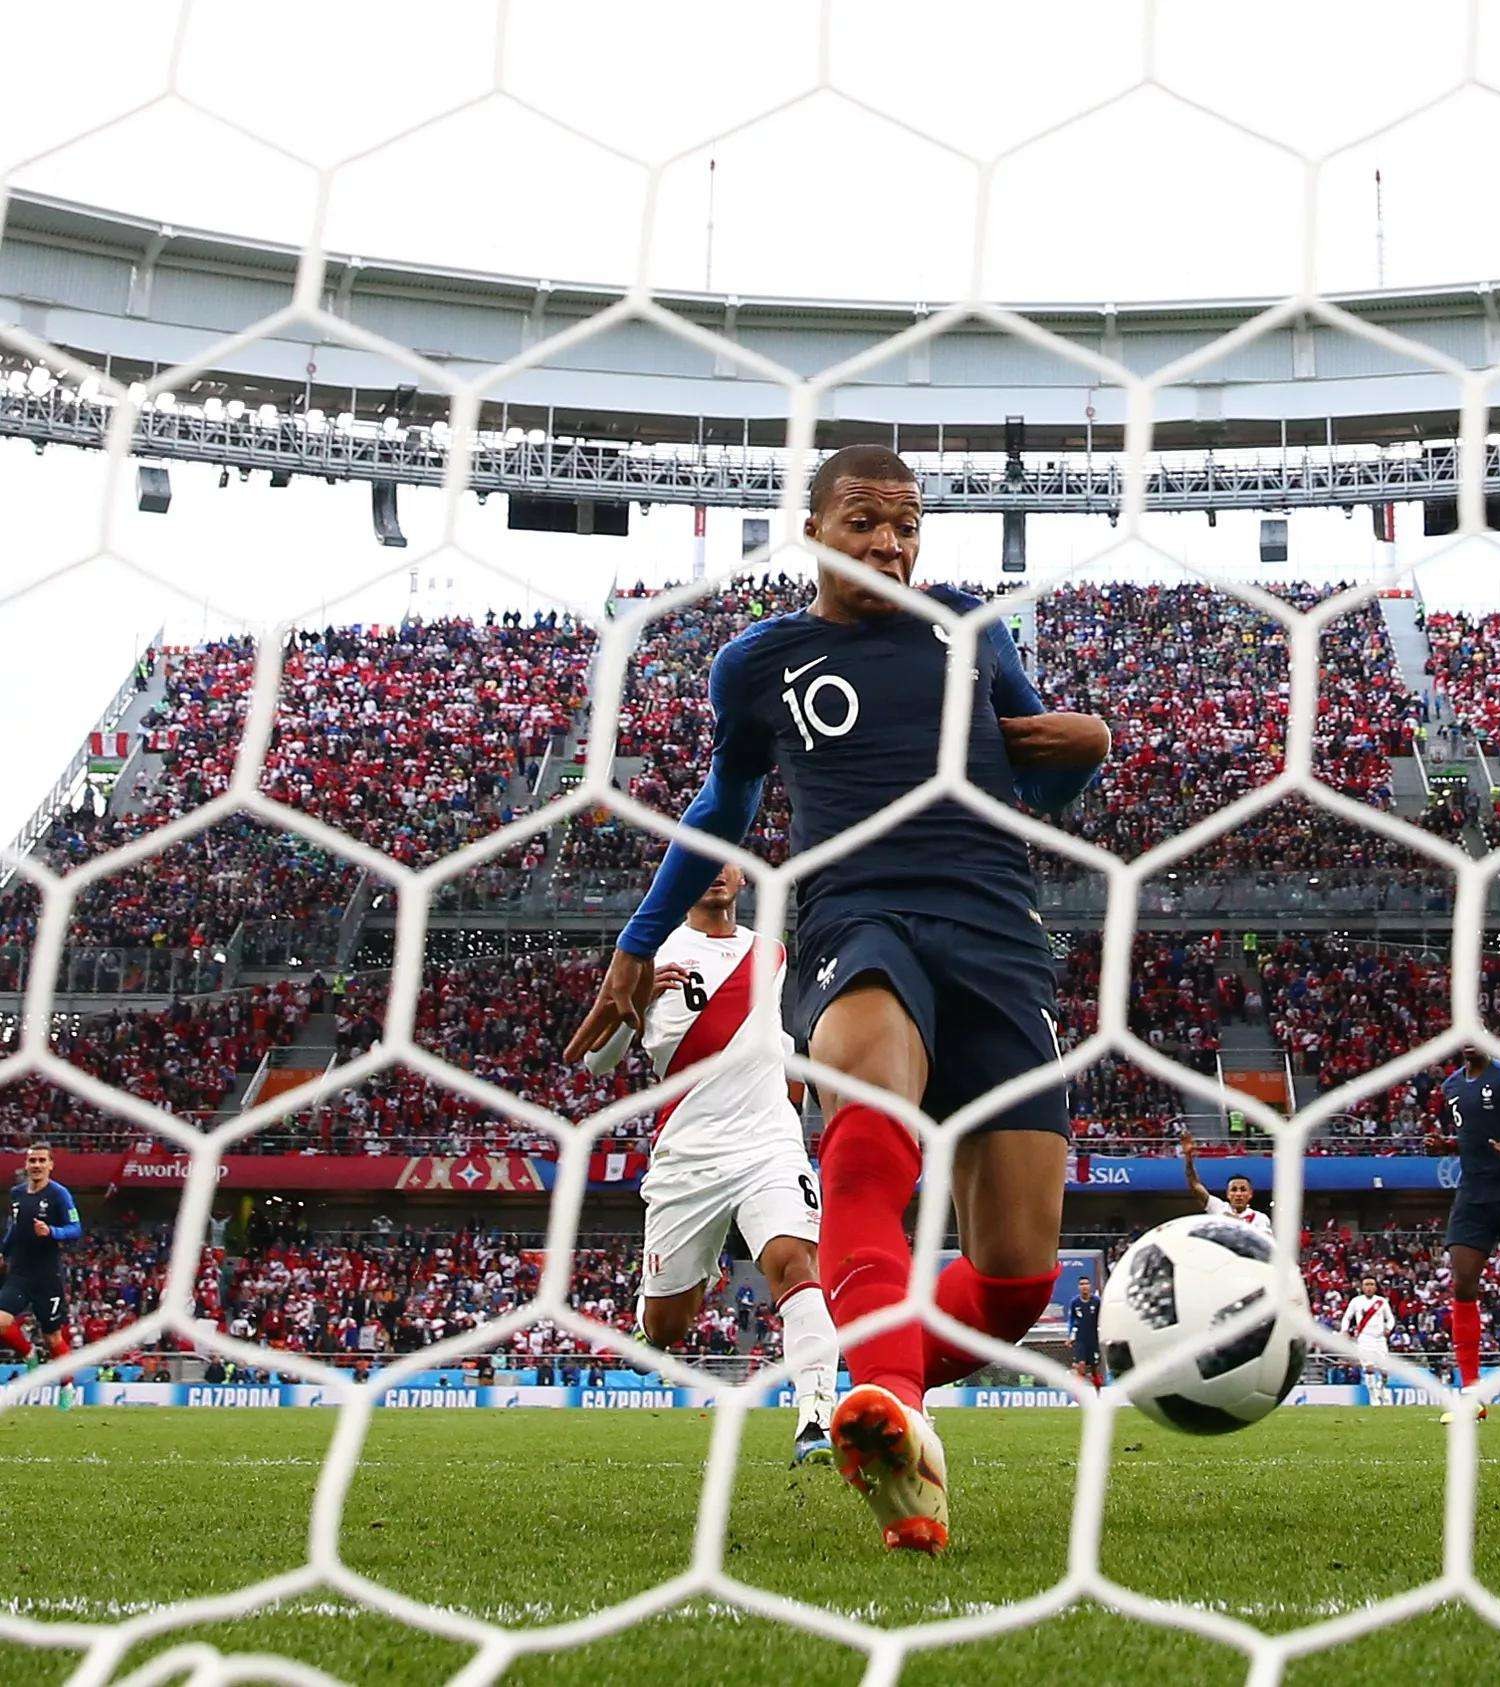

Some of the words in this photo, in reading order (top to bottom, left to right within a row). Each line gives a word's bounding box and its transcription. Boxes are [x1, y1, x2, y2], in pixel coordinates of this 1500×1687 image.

[782, 675, 859, 751] 10
[682, 971, 707, 1011] 6
[1452, 1103, 1463, 1127] 6
[123, 1160, 228, 1182] #worldp
[50, 1297, 60, 1315] 7
[188, 1387, 280, 1408] GAZPROM
[385, 1389, 477, 1409] GAZPROM
[581, 1390, 674, 1409] GAZPROM
